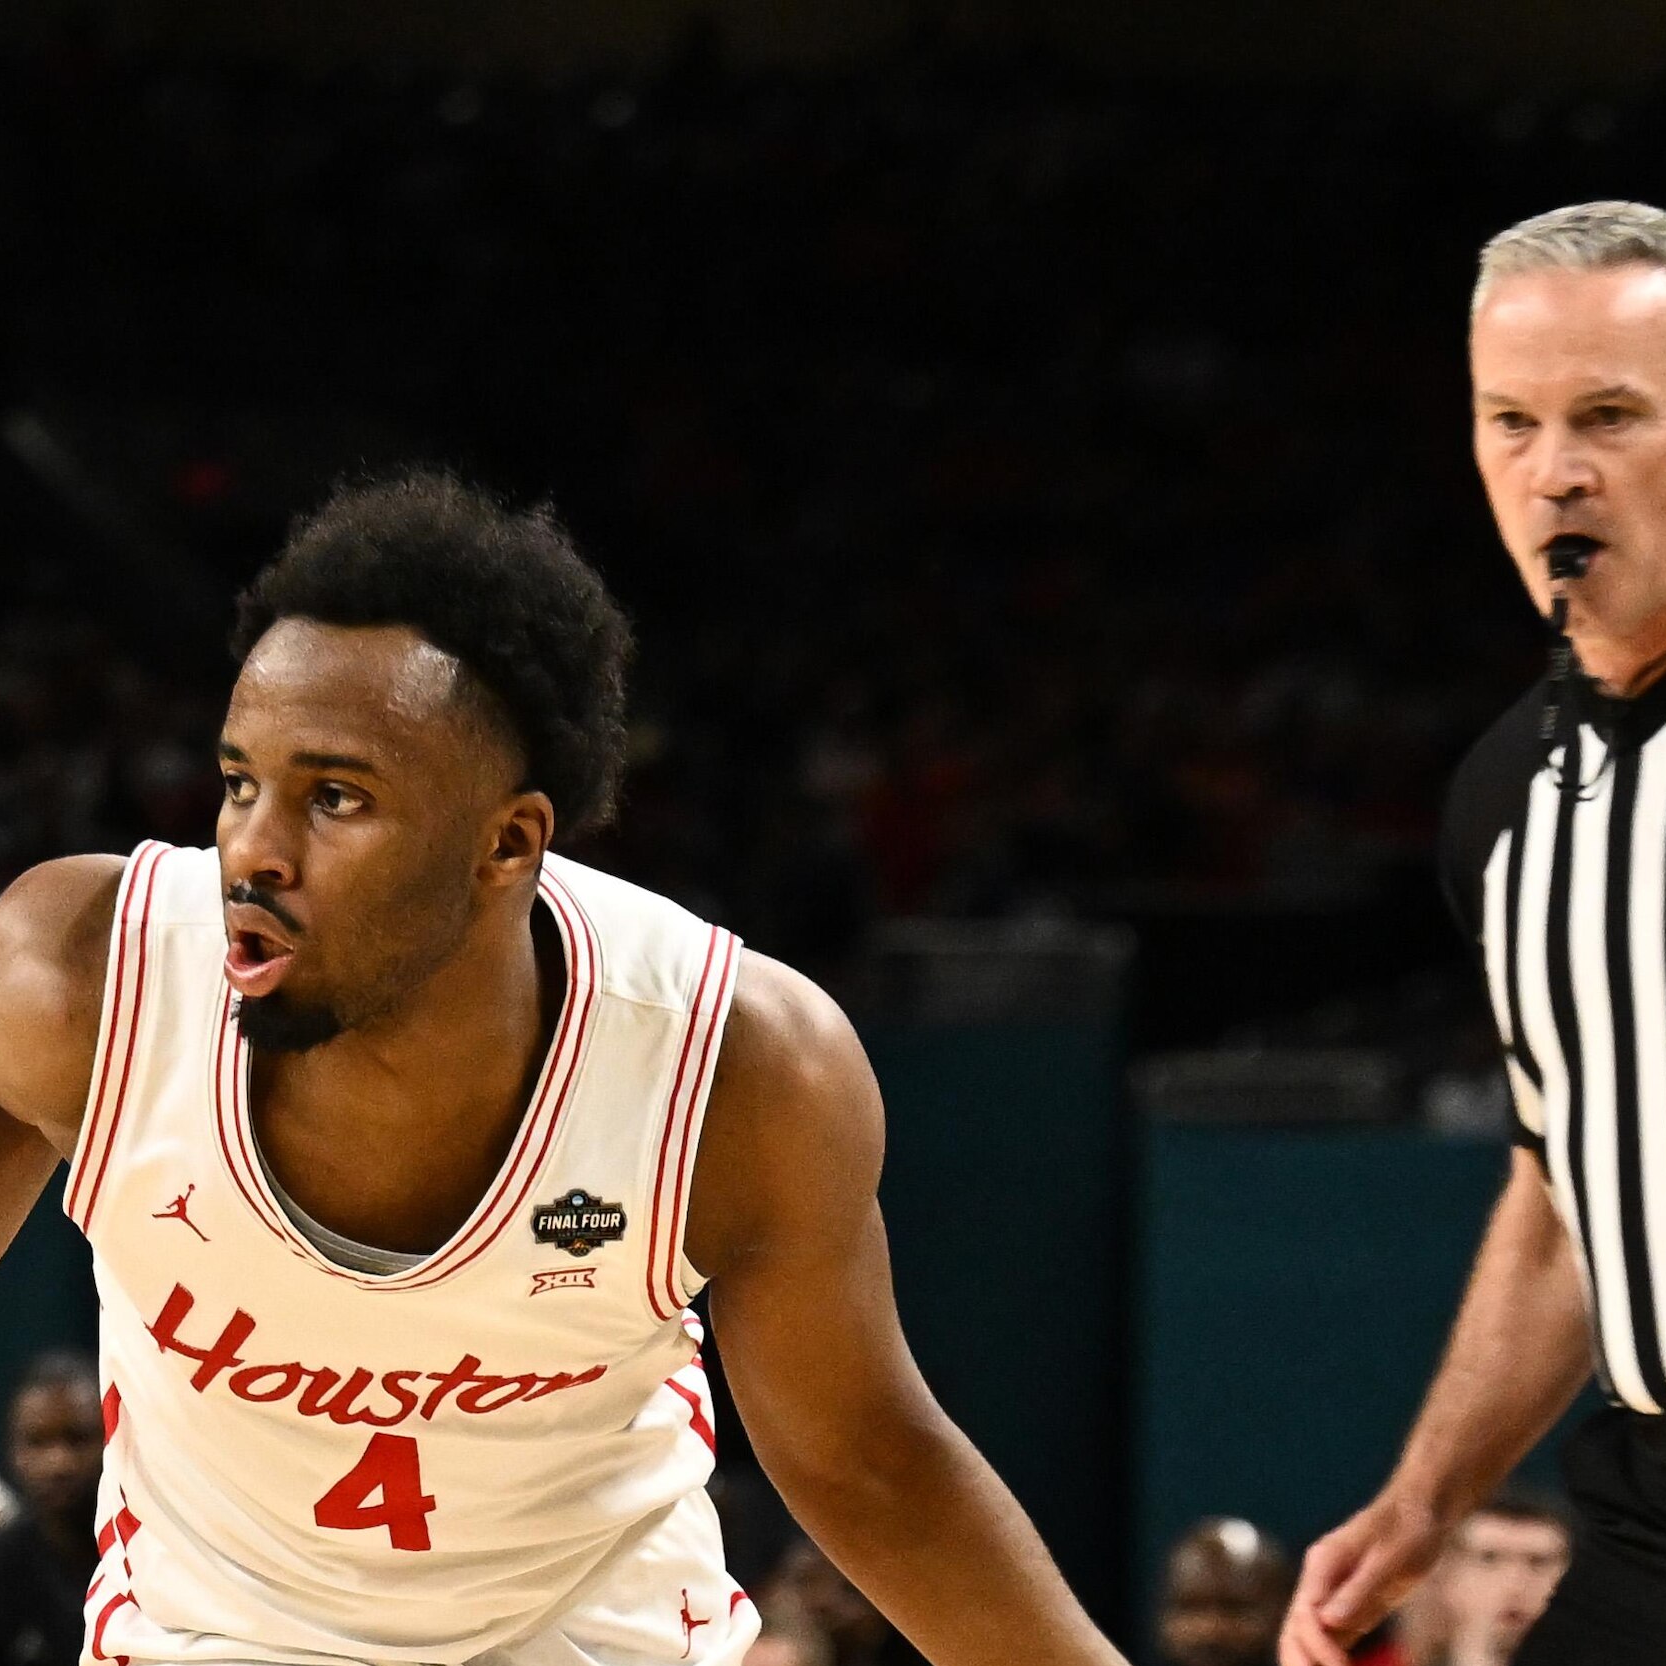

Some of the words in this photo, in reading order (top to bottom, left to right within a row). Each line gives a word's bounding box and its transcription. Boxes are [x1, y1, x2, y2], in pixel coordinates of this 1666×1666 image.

[538, 1213, 579, 1231] FINAL
[581, 1212, 621, 1229] FOUR
[143, 1282, 609, 1427] Houston
[313, 1431, 437, 1552] 4
